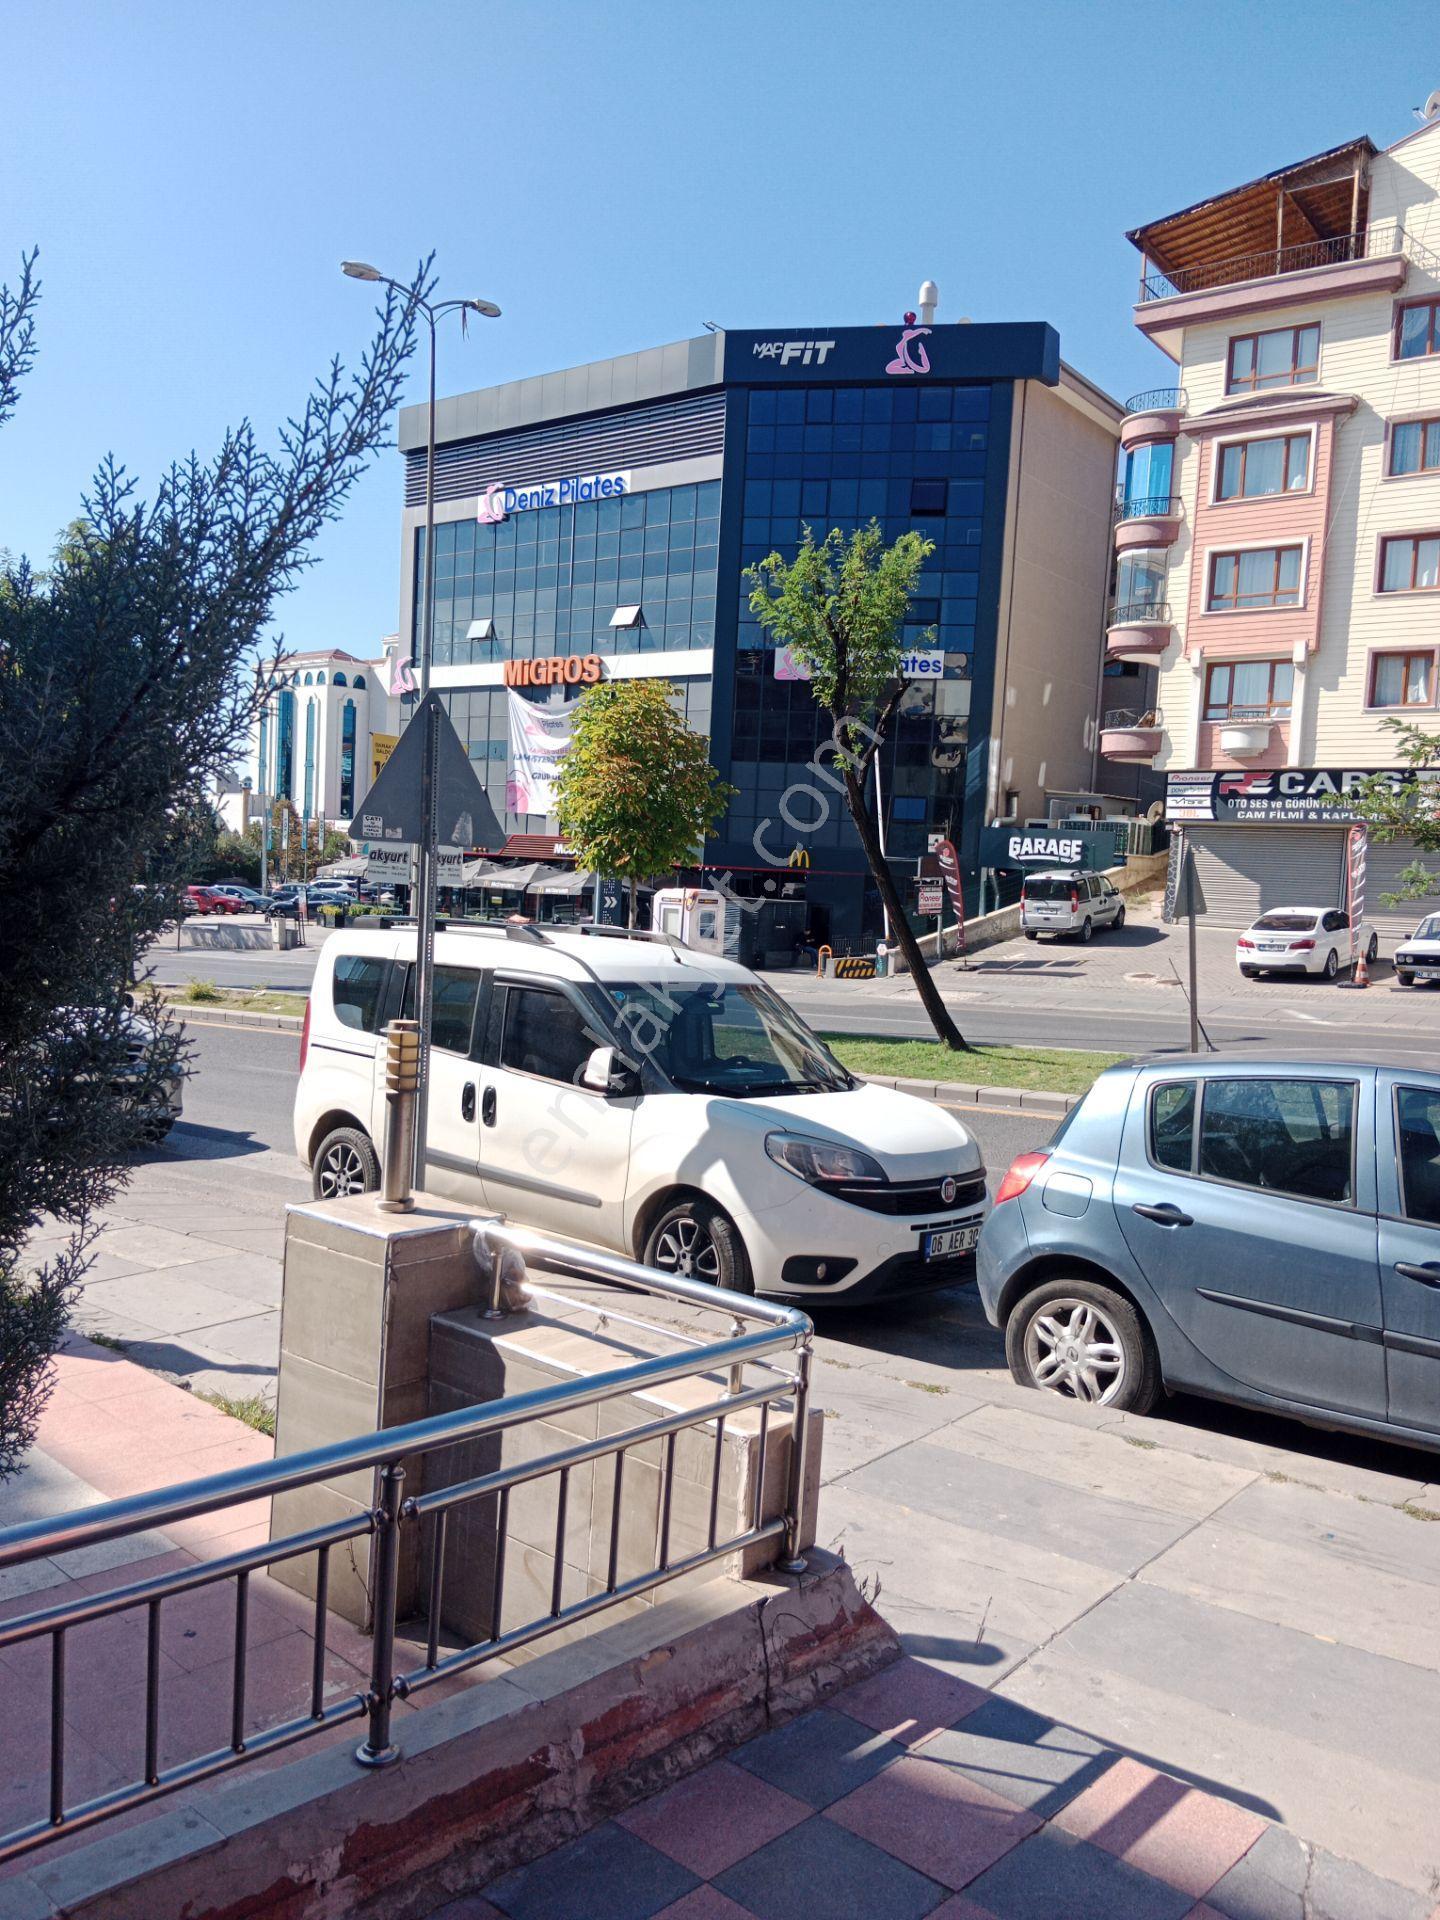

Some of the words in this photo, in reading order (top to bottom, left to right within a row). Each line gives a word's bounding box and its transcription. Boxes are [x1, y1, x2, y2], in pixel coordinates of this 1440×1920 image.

[504, 484, 555, 513] Deniz
[558, 475, 624, 504] Pilates
[1227, 798, 1247, 809] OTO
[1249, 798, 1268, 809] SES
[1270, 800, 1282, 809] ve
[1237, 810, 1266, 819] CAM
[1307, 811, 1318, 820] &
[370, 848, 408, 864] akyurt
[1008, 836, 1083, 864] GARAGE
[931, 1235, 943, 1254] 06
[948, 1230, 966, 1252] AER
